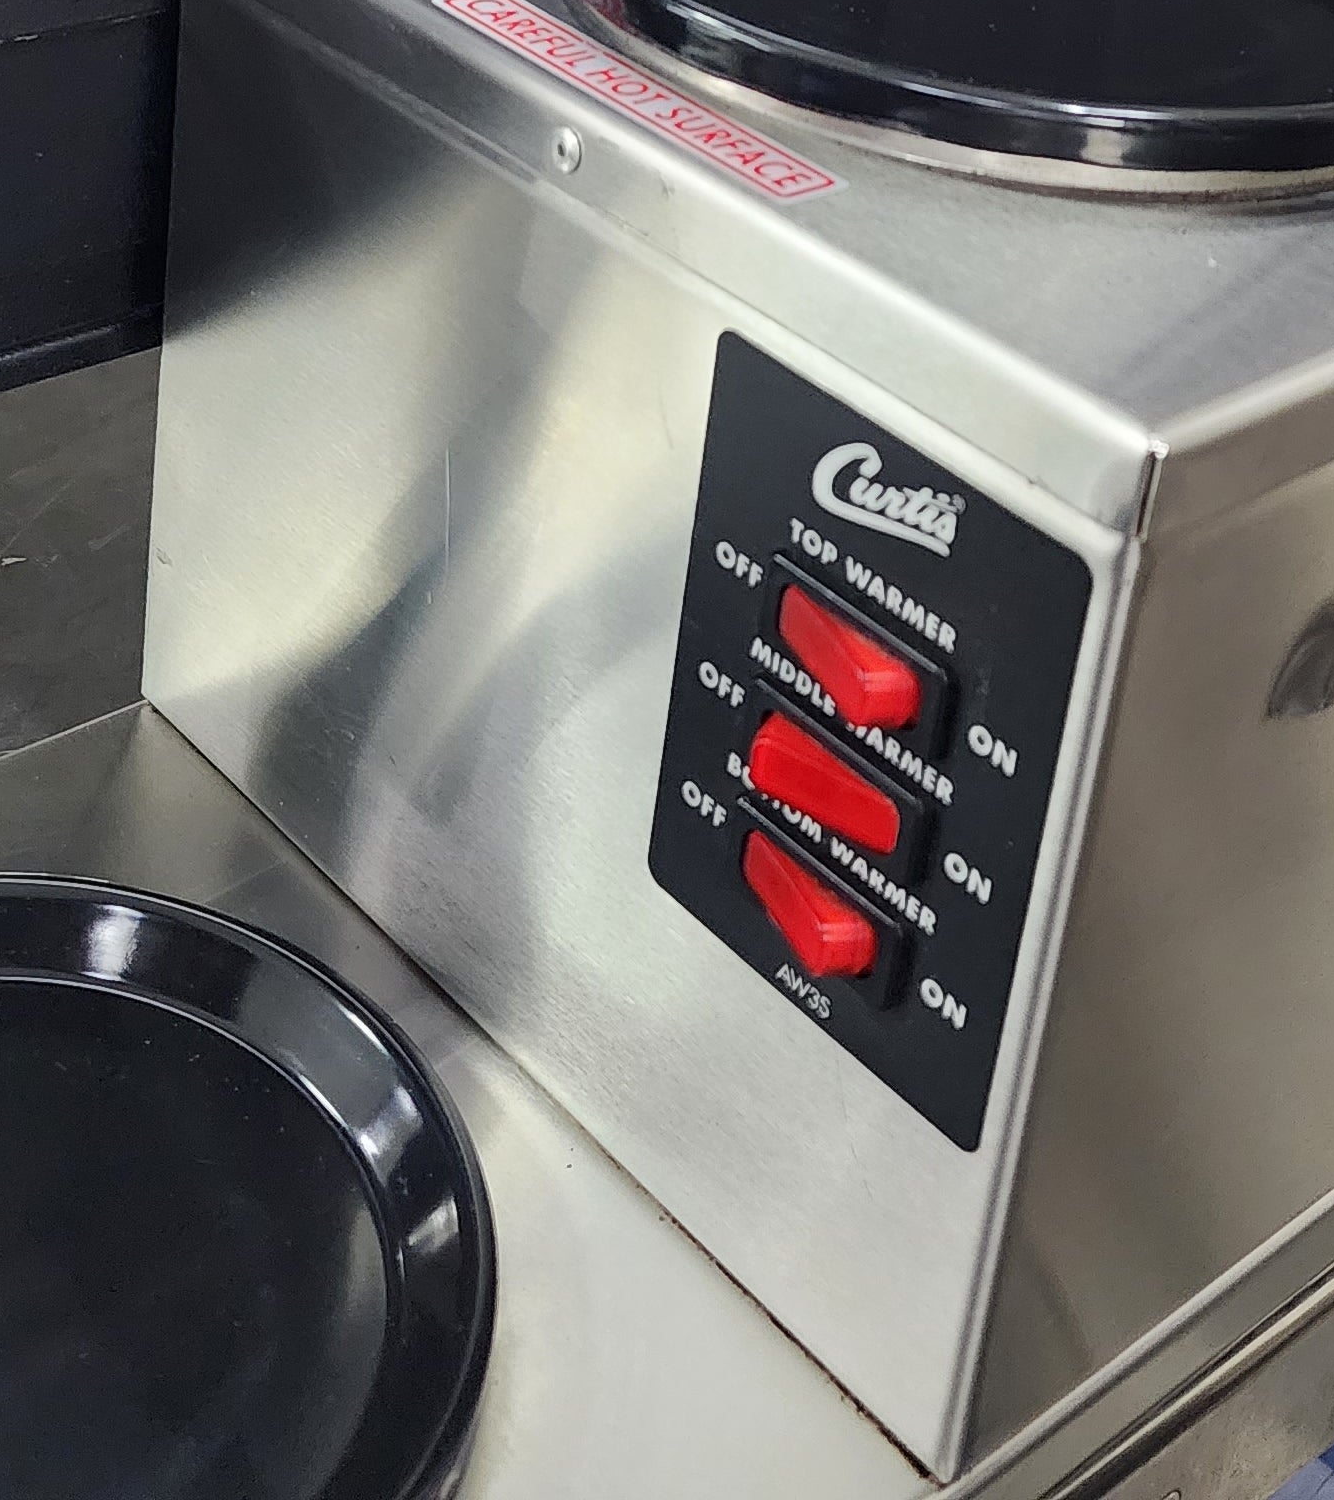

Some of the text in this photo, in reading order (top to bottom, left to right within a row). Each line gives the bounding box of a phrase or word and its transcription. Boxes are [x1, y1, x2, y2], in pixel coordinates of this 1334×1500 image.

[585, 65, 666, 106] HOT
[655, 104, 814, 190] SURFACE
[811, 442, 959, 558] Curtis
[713, 539, 764, 589] OFF
[788, 516, 957, 654] TOP WARMER
[696, 660, 746, 708] OFF
[748, 635, 837, 718] MIDDLE
[966, 724, 1019, 779] ON
[680, 779, 728, 828] OFF
[829, 834, 939, 937] WARMER
[942, 851, 993, 906] ON
[774, 962, 834, 1021] AW3S
[918, 977, 968, 1032] ON
